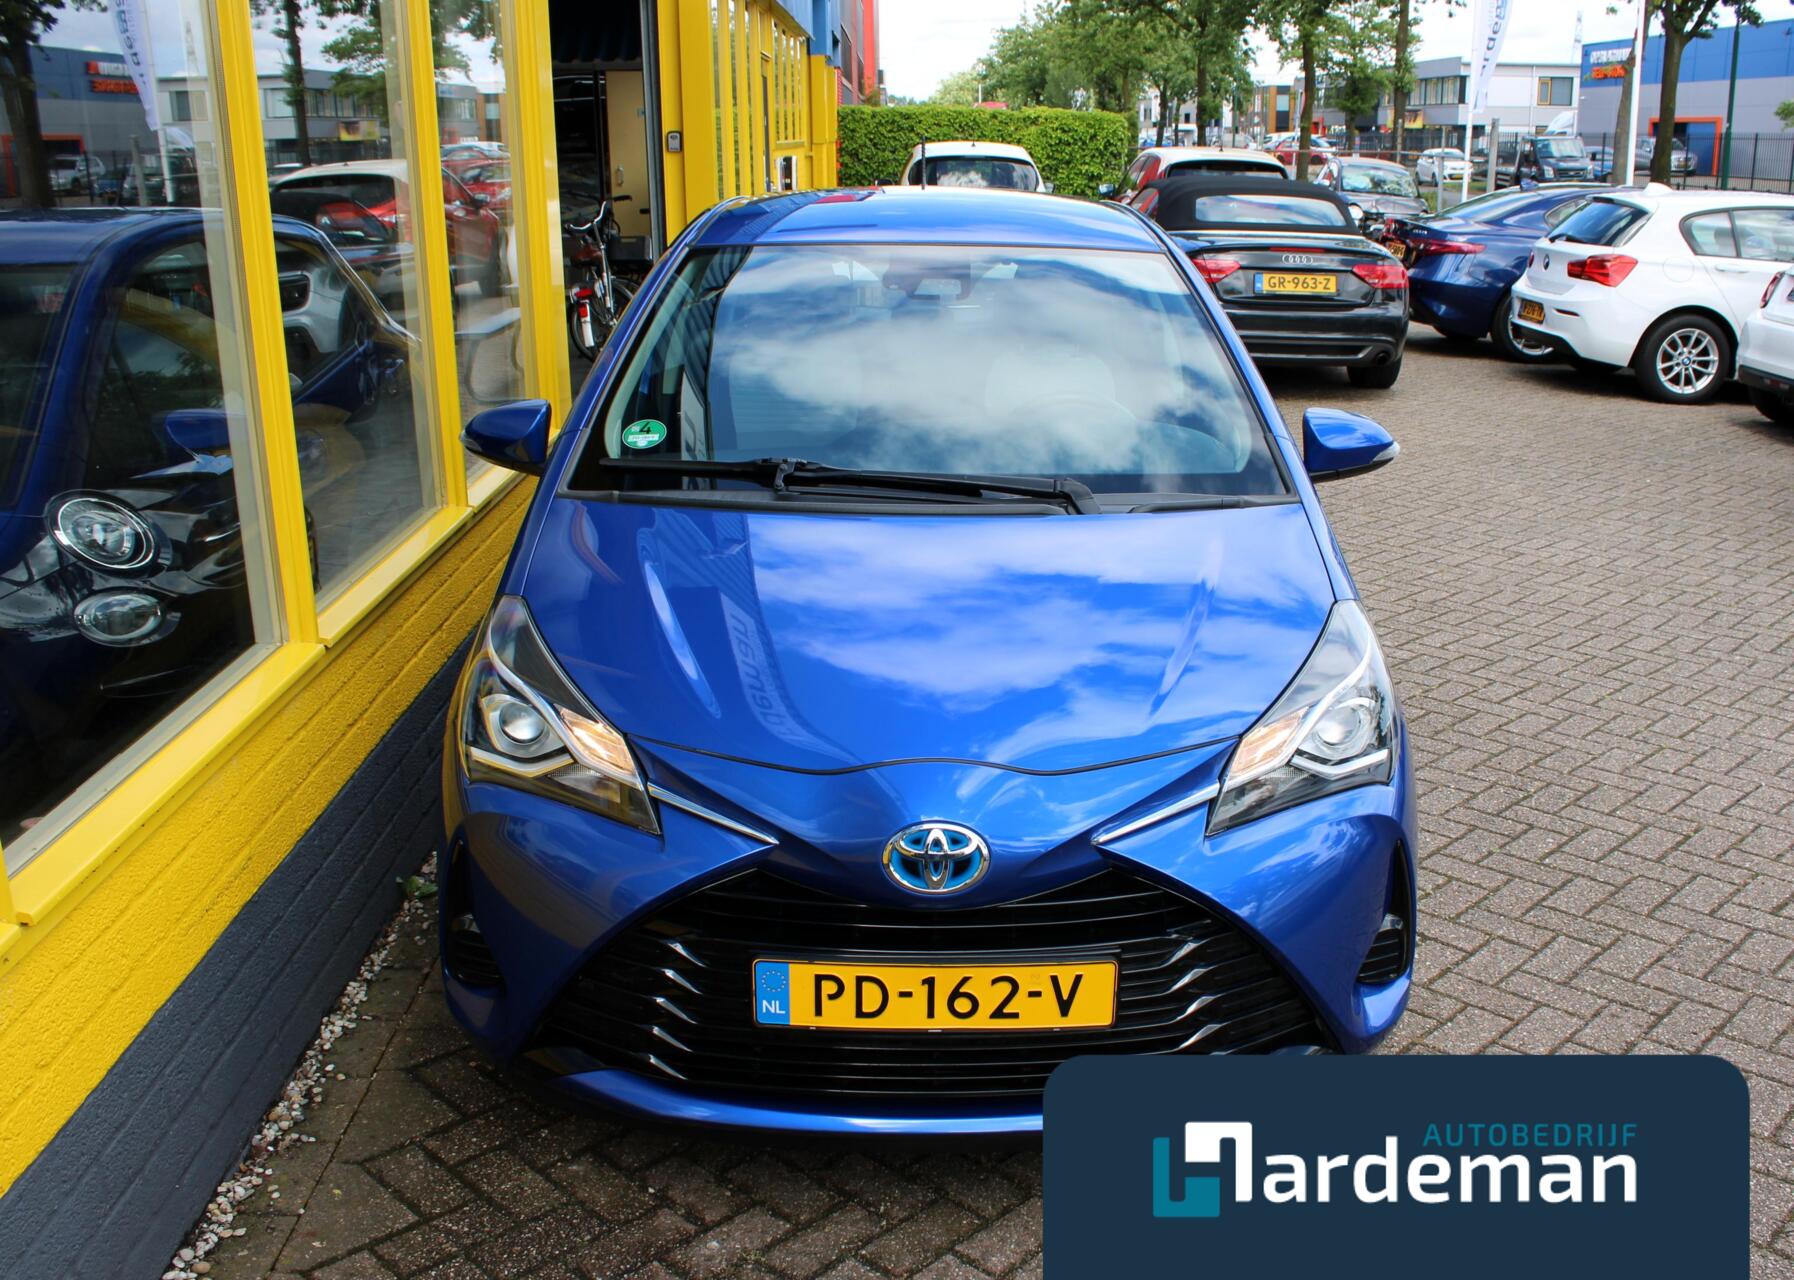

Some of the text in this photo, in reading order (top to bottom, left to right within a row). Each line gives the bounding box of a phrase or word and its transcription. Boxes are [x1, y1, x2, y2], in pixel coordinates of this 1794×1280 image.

[1268, 276, 1331, 291] GR-963-Z
[639, 421, 652, 435] 4
[813, 973, 1084, 1019] PD-162-V
[762, 999, 786, 1015] NL
